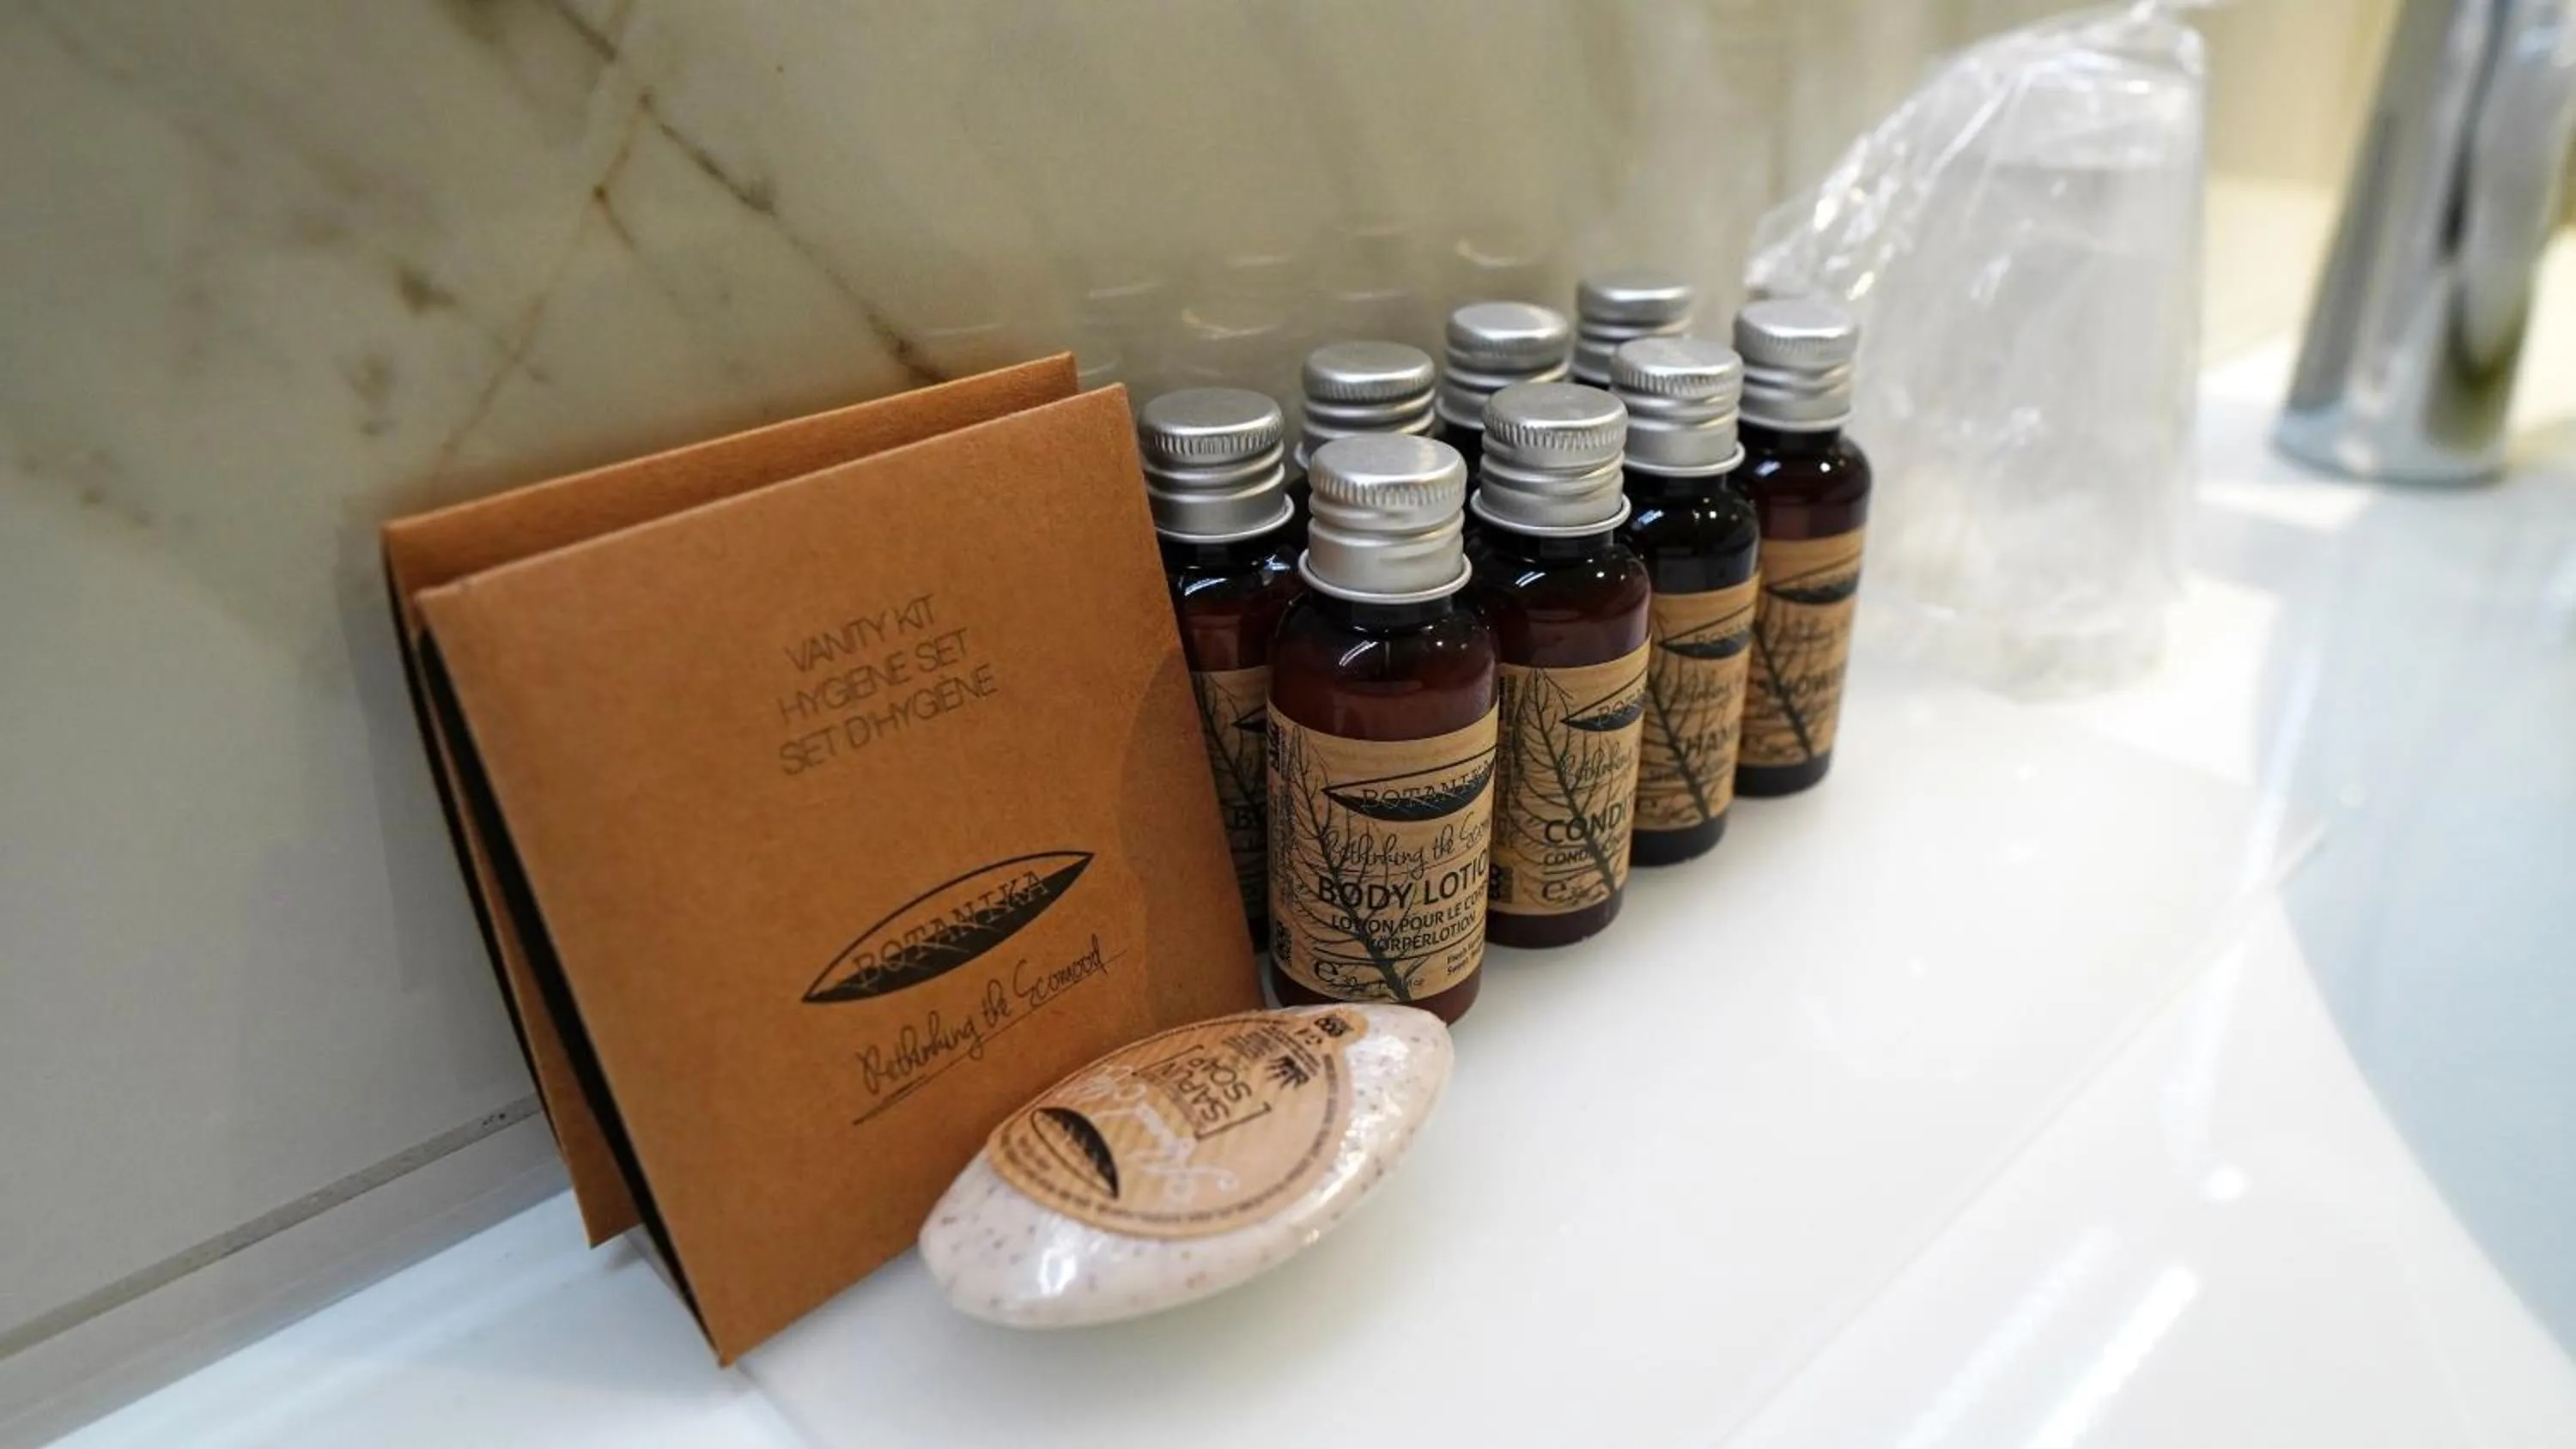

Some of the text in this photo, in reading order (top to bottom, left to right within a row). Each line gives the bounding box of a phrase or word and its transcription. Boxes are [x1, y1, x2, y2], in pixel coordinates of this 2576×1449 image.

[782, 593, 934, 673] VANITY KIT
[777, 627, 968, 726] HYGIENE SET
[779, 724, 839, 776] SET
[1318, 874, 1413, 912] BODY
[1423, 847, 1490, 906] LOTIO
[854, 870, 1050, 987] BOTANIKA
[1331, 913, 1395, 936] LOON
[1397, 911, 1445, 934] POUR
[1447, 902, 1462, 919] LE
[981, 979, 1012, 1028] the
[1187, 1057, 1253, 1102] SOAP
